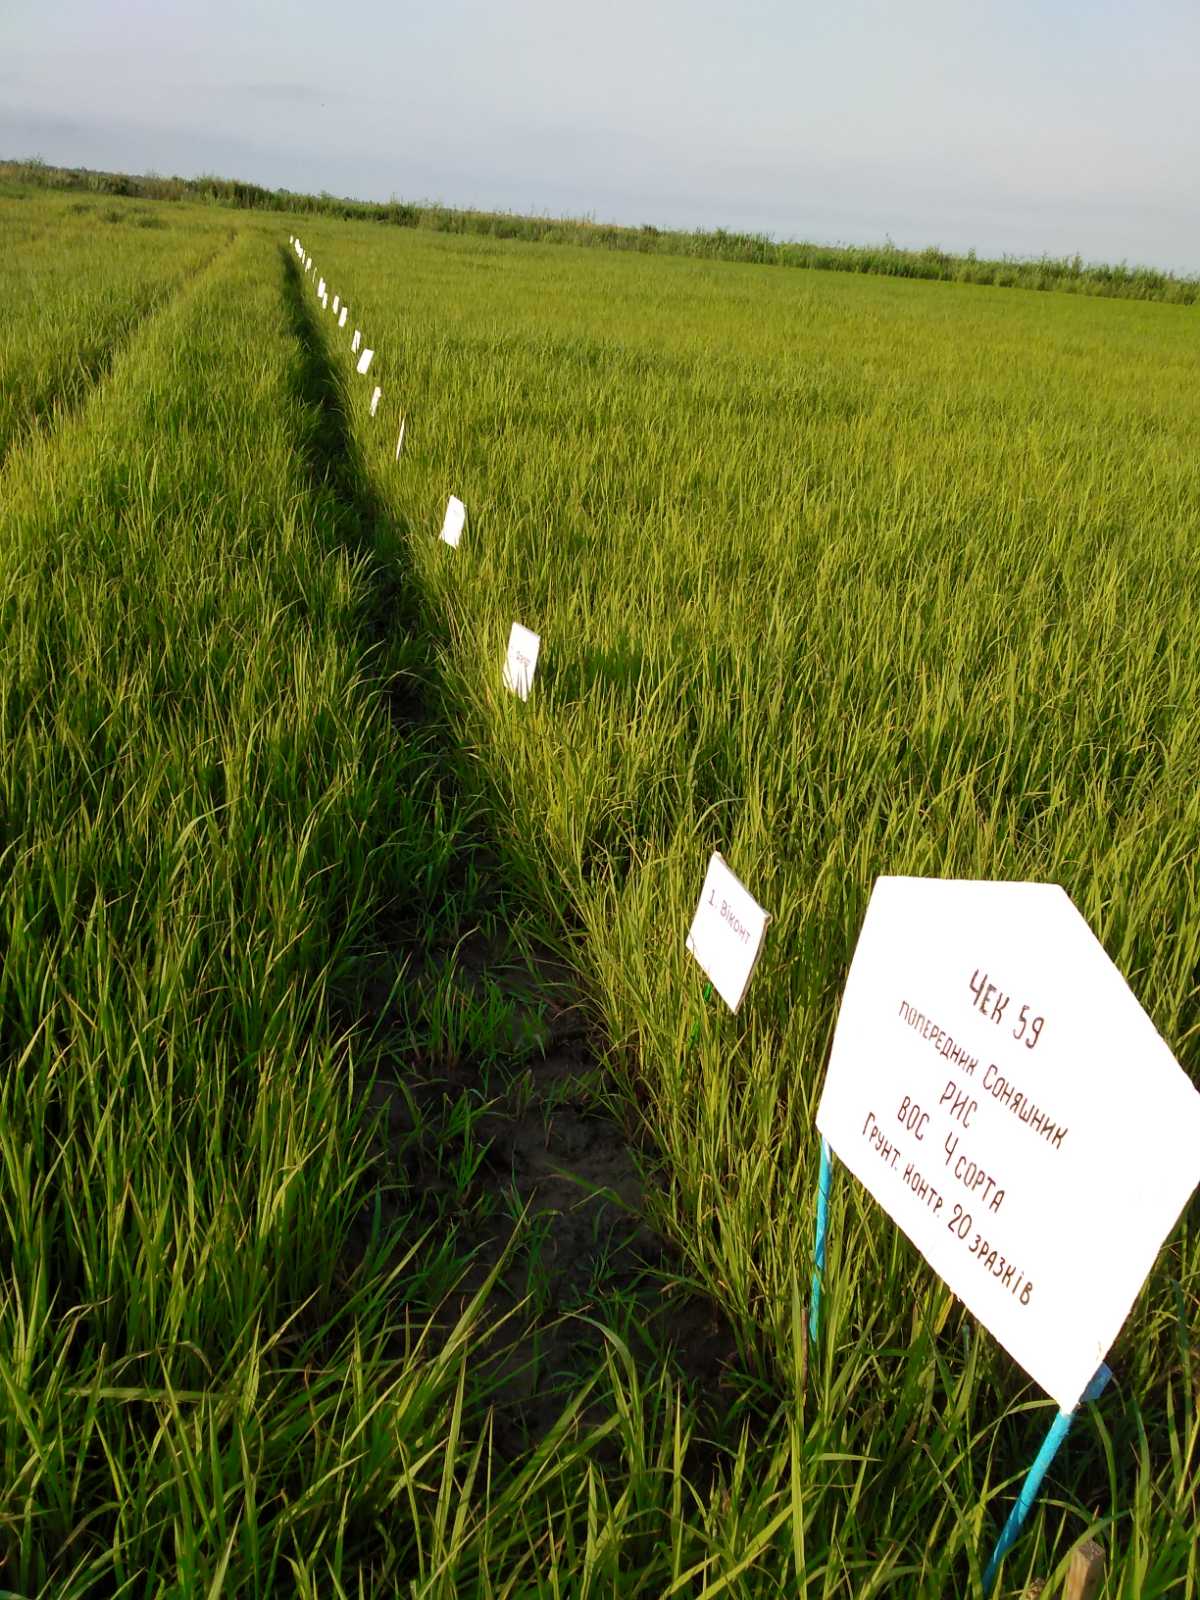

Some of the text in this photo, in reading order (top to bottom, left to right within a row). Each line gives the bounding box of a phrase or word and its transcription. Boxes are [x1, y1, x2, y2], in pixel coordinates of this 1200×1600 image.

[969, 969, 1045, 1050] ЧЕК 59
[897, 1095, 930, 1141] ВОС
[944, 1131, 959, 1166] 4
[939, 1080, 978, 1129] РИС
[947, 1203, 973, 1240] 20
